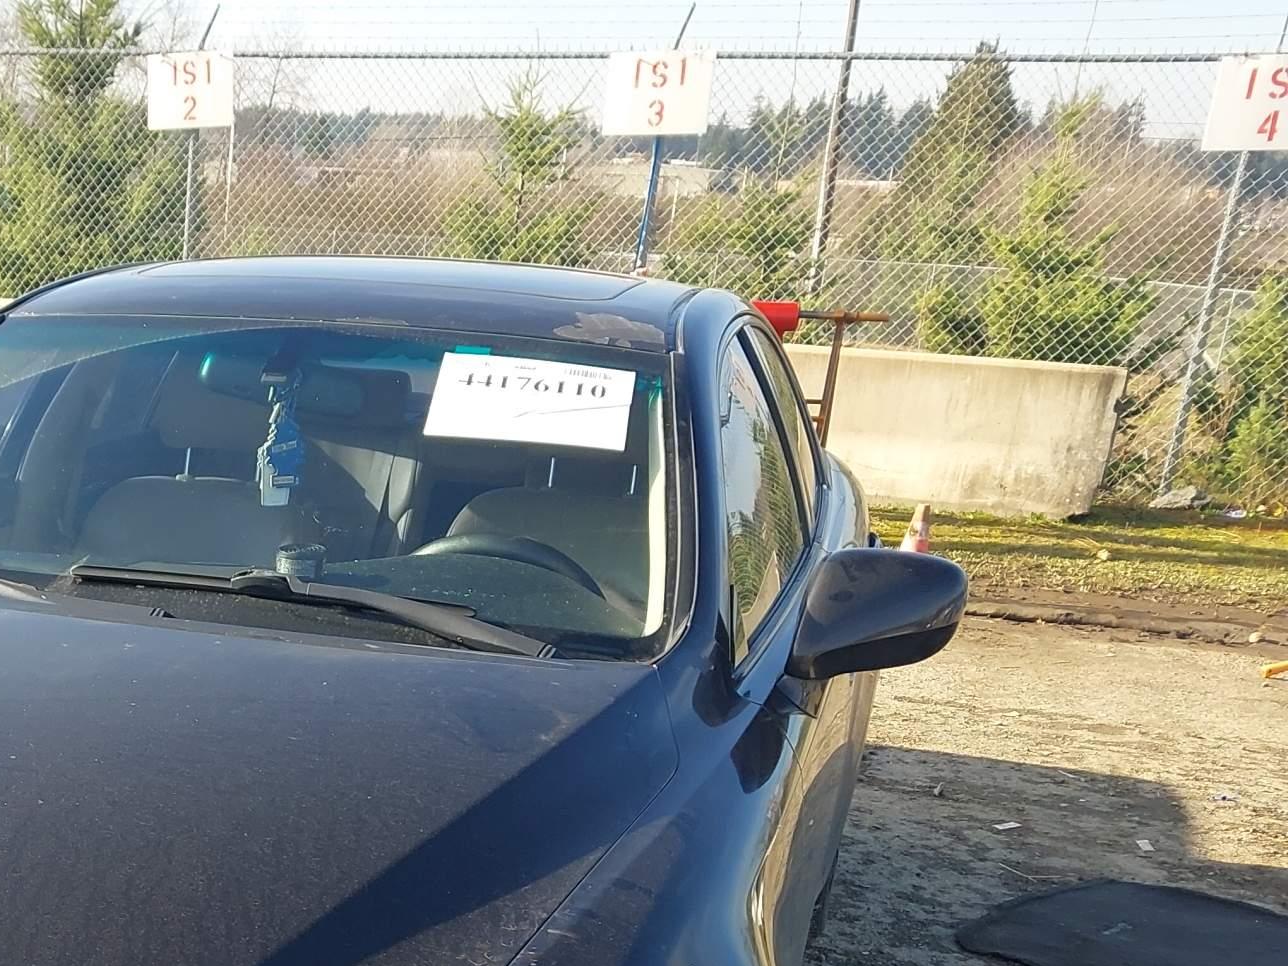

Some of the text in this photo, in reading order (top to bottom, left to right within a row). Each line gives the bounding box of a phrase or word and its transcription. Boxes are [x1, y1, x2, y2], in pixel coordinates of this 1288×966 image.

[183, 95, 197, 121] 2
[647, 99, 665, 128] 3
[1256, 110, 1280, 142] 4
[457, 372, 607, 399] 44176110
